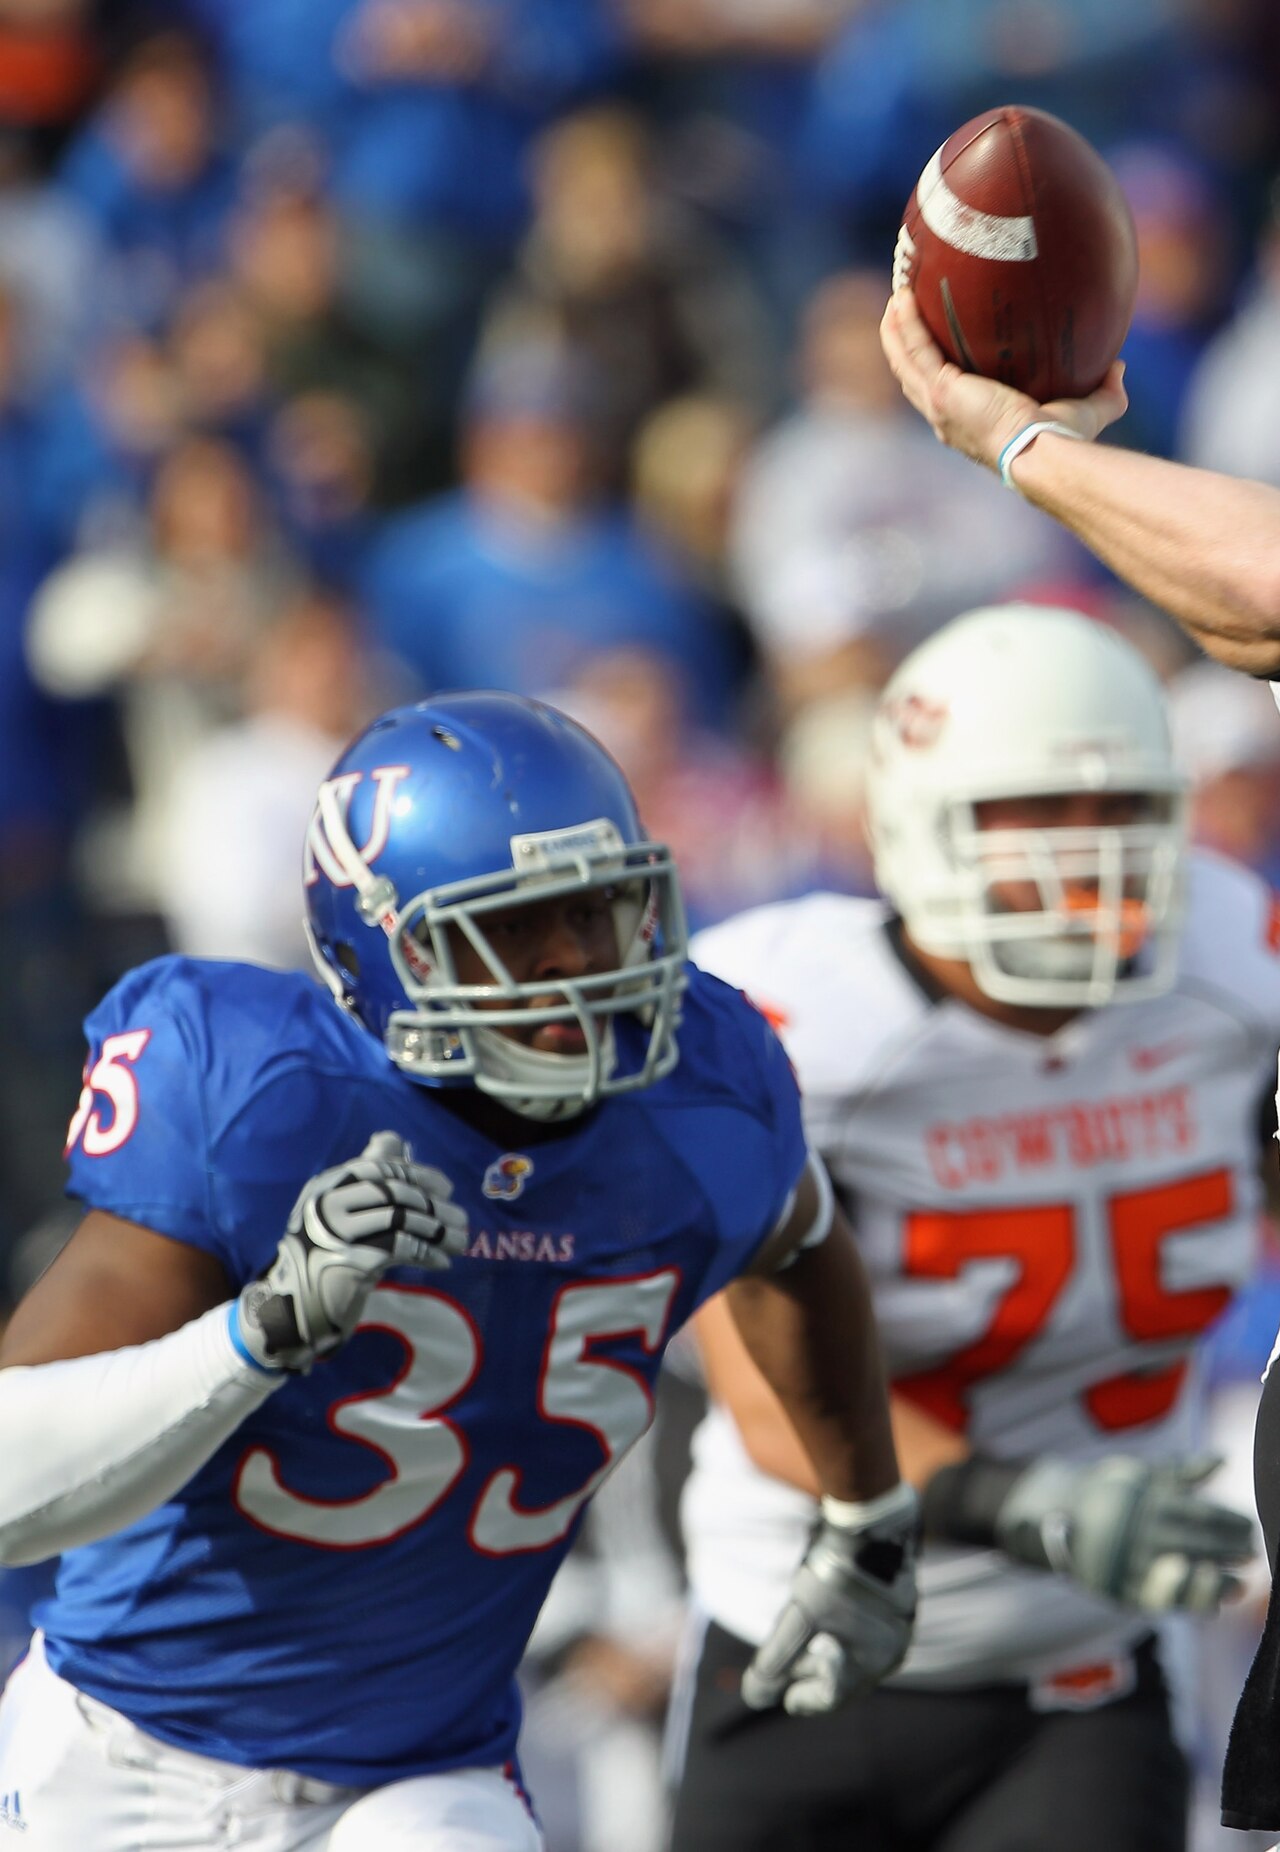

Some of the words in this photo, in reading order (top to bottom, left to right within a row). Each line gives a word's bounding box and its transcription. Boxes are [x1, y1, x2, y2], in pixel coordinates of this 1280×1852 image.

[463, 1229, 576, 1262] ANSAS
[890, 1162, 1236, 1437] 75
[233, 1267, 684, 1559] 35
